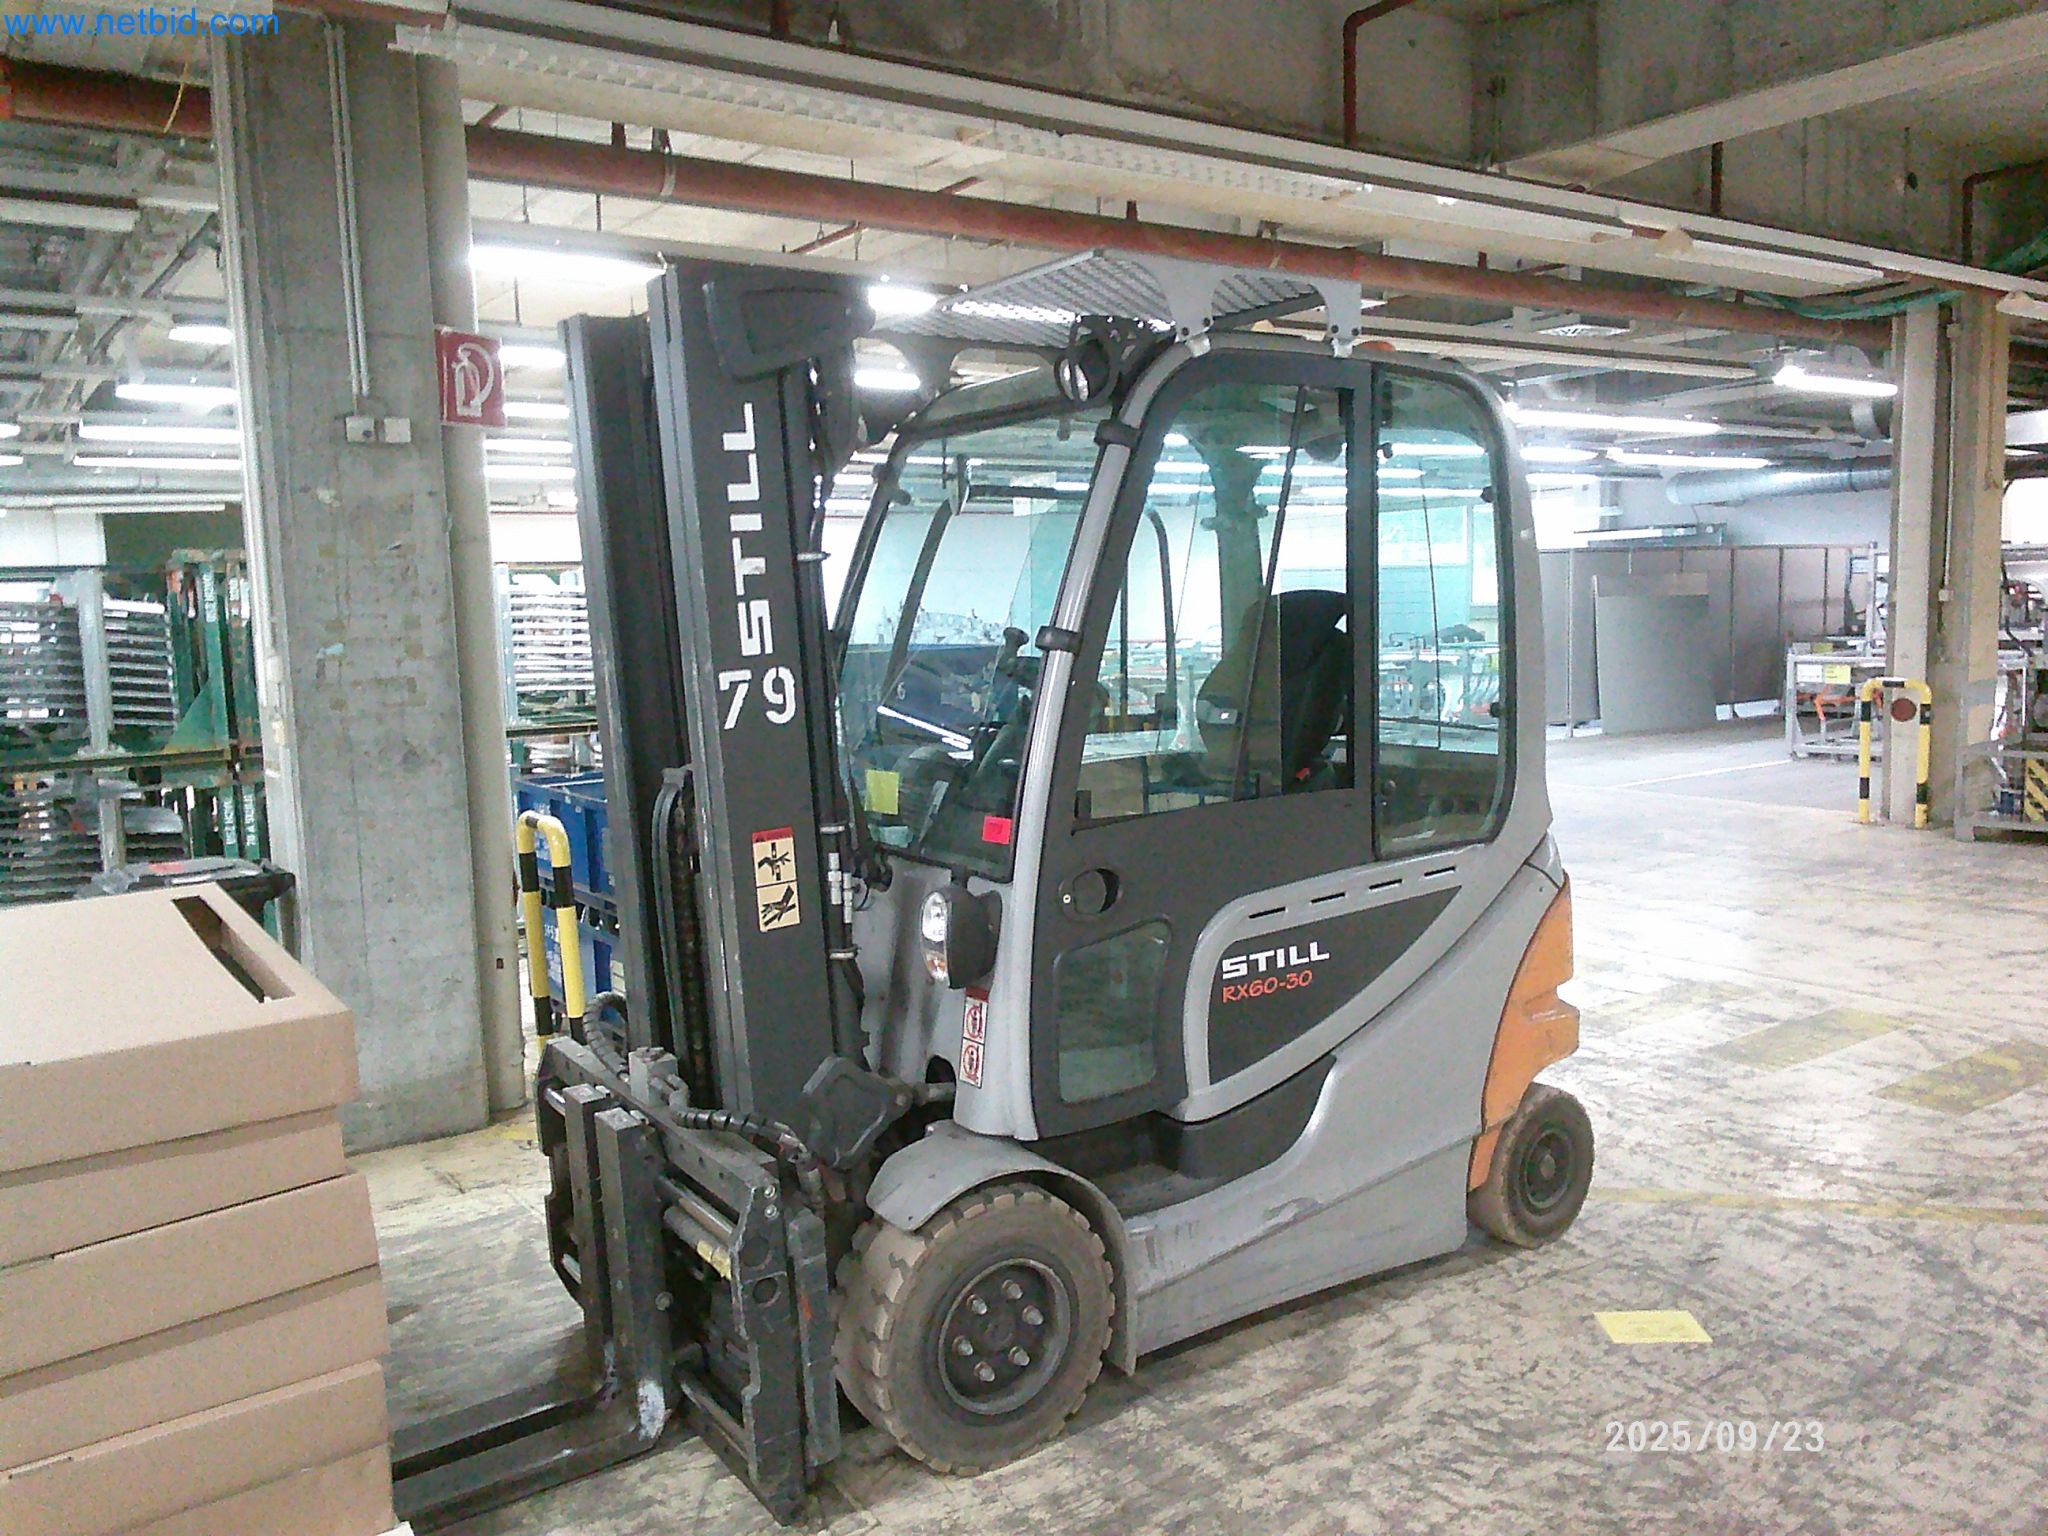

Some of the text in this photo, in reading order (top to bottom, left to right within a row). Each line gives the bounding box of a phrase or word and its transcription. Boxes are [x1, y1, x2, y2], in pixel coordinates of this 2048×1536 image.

[723, 402, 774, 655] STILL
[718, 666, 796, 730] 79
[1222, 941, 1330, 980] STILL
[1222, 969, 1313, 1003] RX60-30
